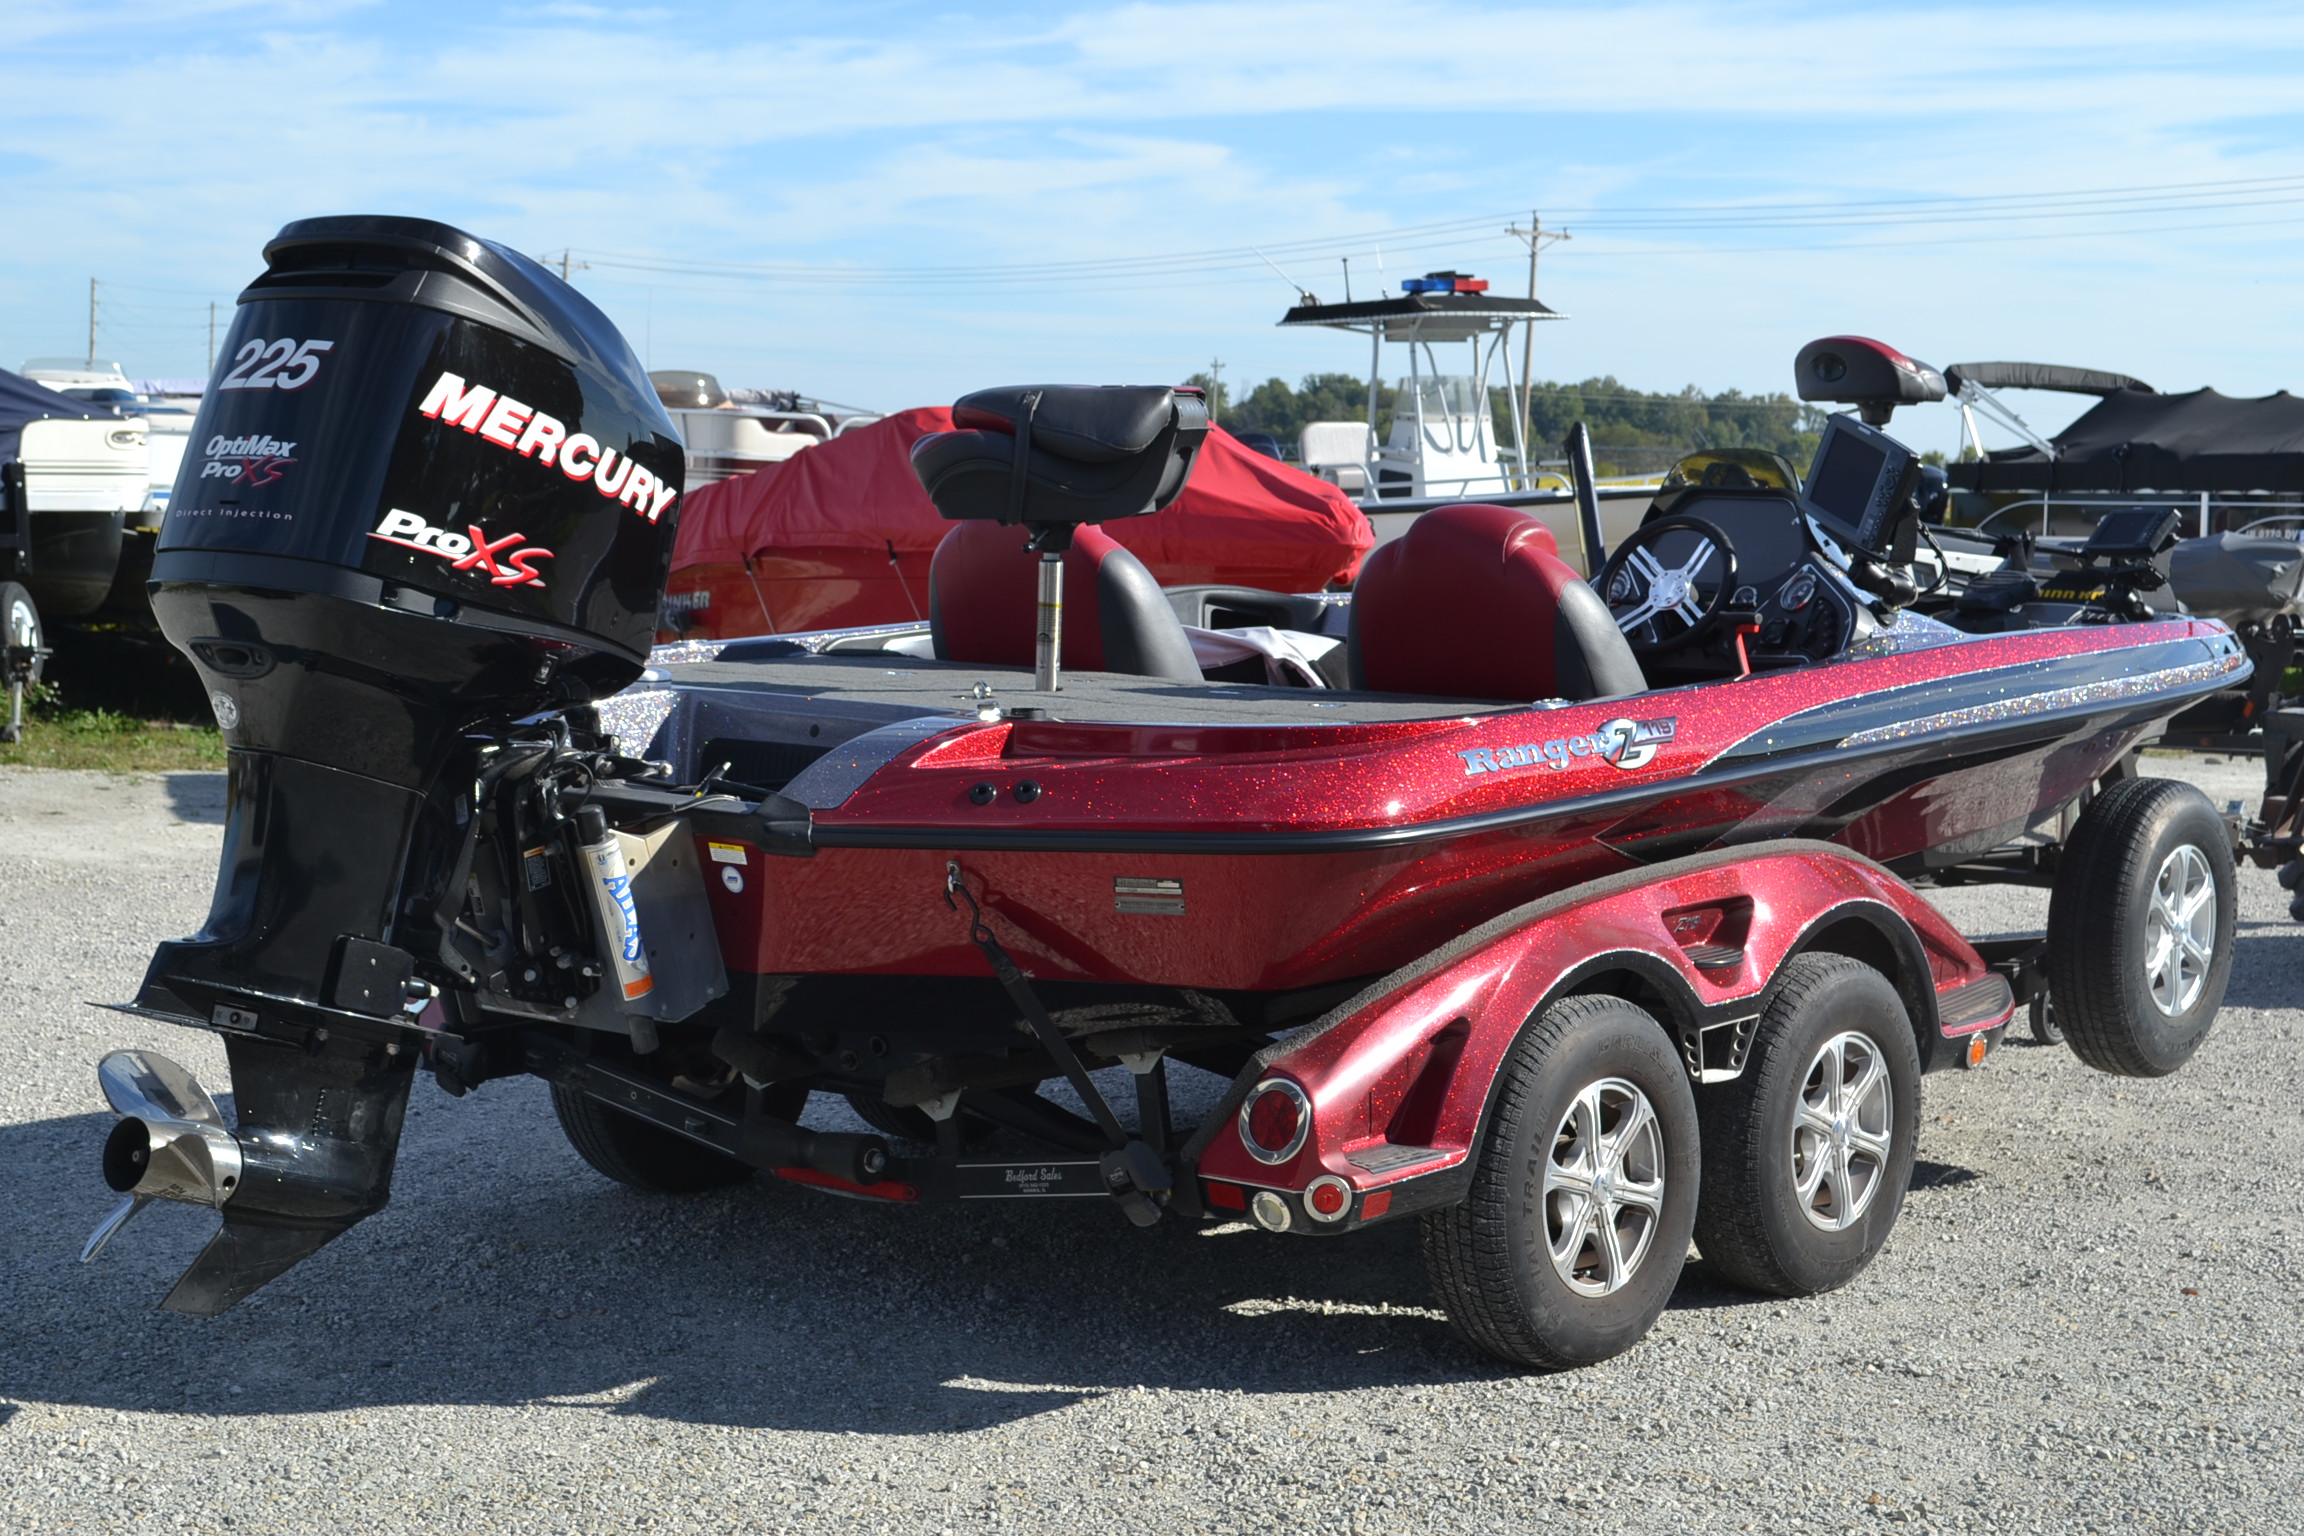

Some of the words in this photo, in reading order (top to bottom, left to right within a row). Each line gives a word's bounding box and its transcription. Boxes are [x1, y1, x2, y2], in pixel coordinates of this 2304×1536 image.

[218, 337, 335, 392] 225
[205, 434, 297, 461] OptiMax
[418, 371, 677, 525] MERCURY
[176, 508, 213, 518] Direct
[220, 508, 293, 520] Injection
[1456, 730, 1610, 776] Ranger
[602, 874, 643, 962] ATLAS
[1005, 1168, 1039, 1184] Bedford
[1040, 1166, 1063, 1181] Sales
